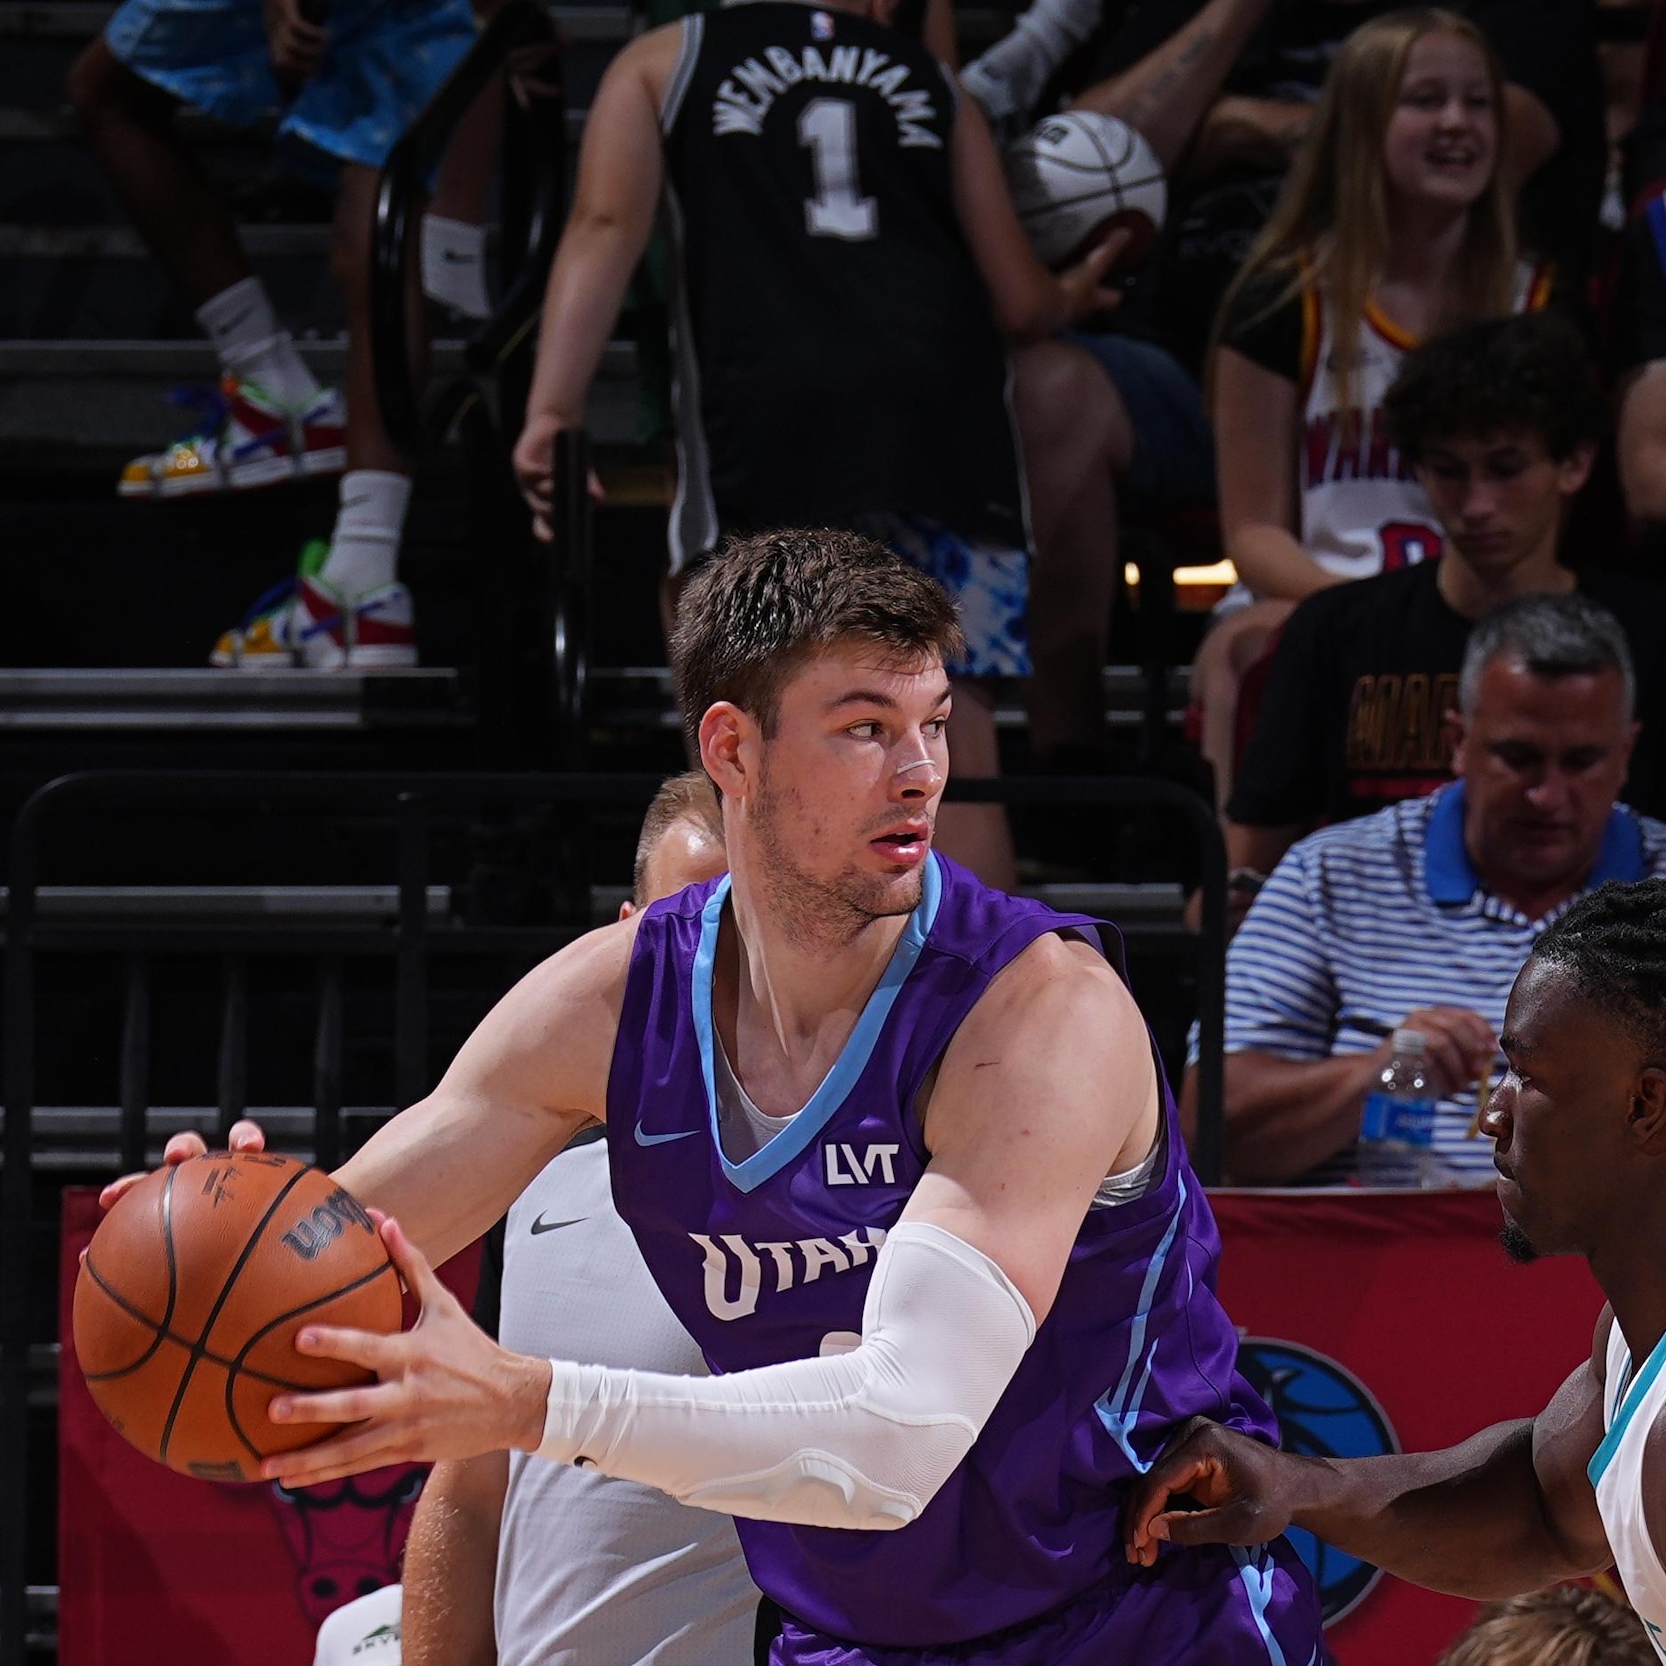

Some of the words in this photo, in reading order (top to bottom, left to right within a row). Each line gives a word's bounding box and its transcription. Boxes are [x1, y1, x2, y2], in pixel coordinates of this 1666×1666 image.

[712, 45, 944, 150] WEMBANYAMA
[796, 98, 881, 242] 1
[824, 1142, 900, 1186] LVT
